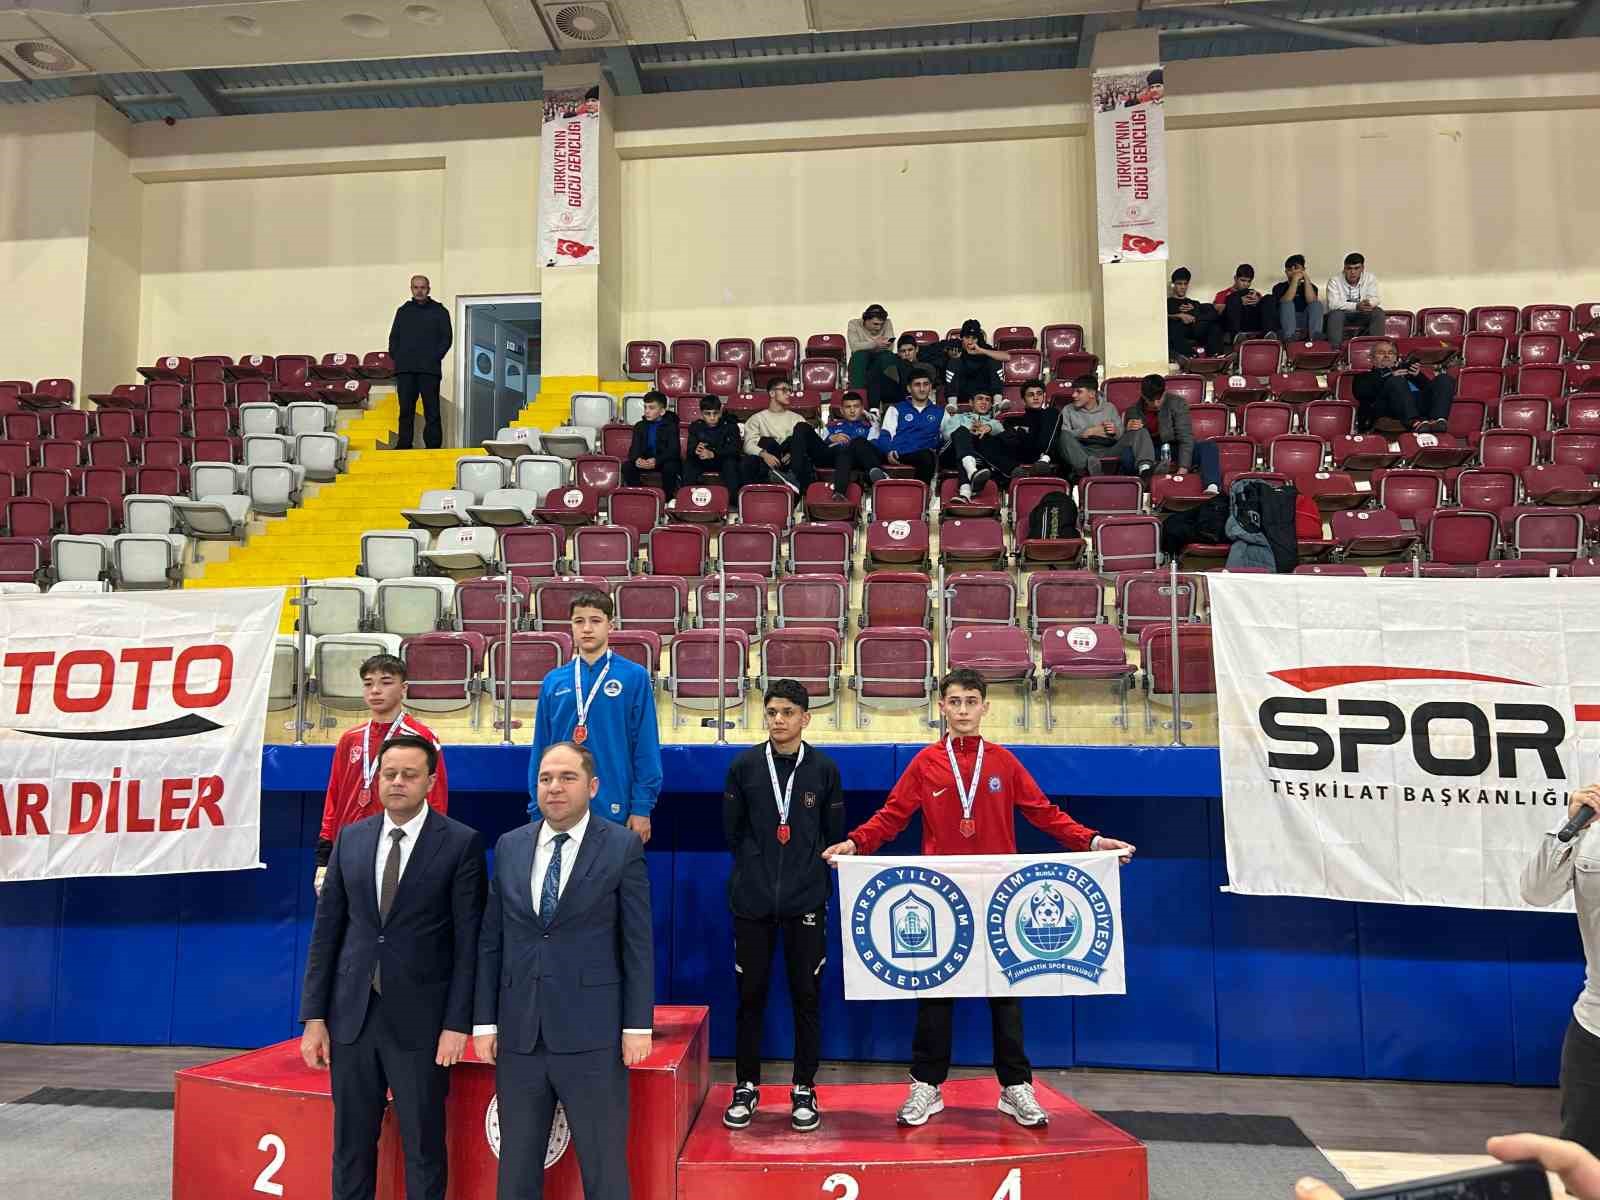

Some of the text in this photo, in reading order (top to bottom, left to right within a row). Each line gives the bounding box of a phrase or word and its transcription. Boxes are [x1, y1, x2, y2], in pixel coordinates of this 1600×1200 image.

[1134, 167, 1149, 200] GÜCÜ
[4, 644, 234, 715] TOTO
[1258, 696, 1567, 780] SPOR
[68, 766, 225, 836] DİLER
[1270, 779, 1569, 807] TEŞKİLAT BAŞKANLIĞI
[855, 869, 969, 935] BURSA YILDIRIM
[990, 872, 1025, 957] YILDIRIM
[253, 1132, 287, 1197] 2
